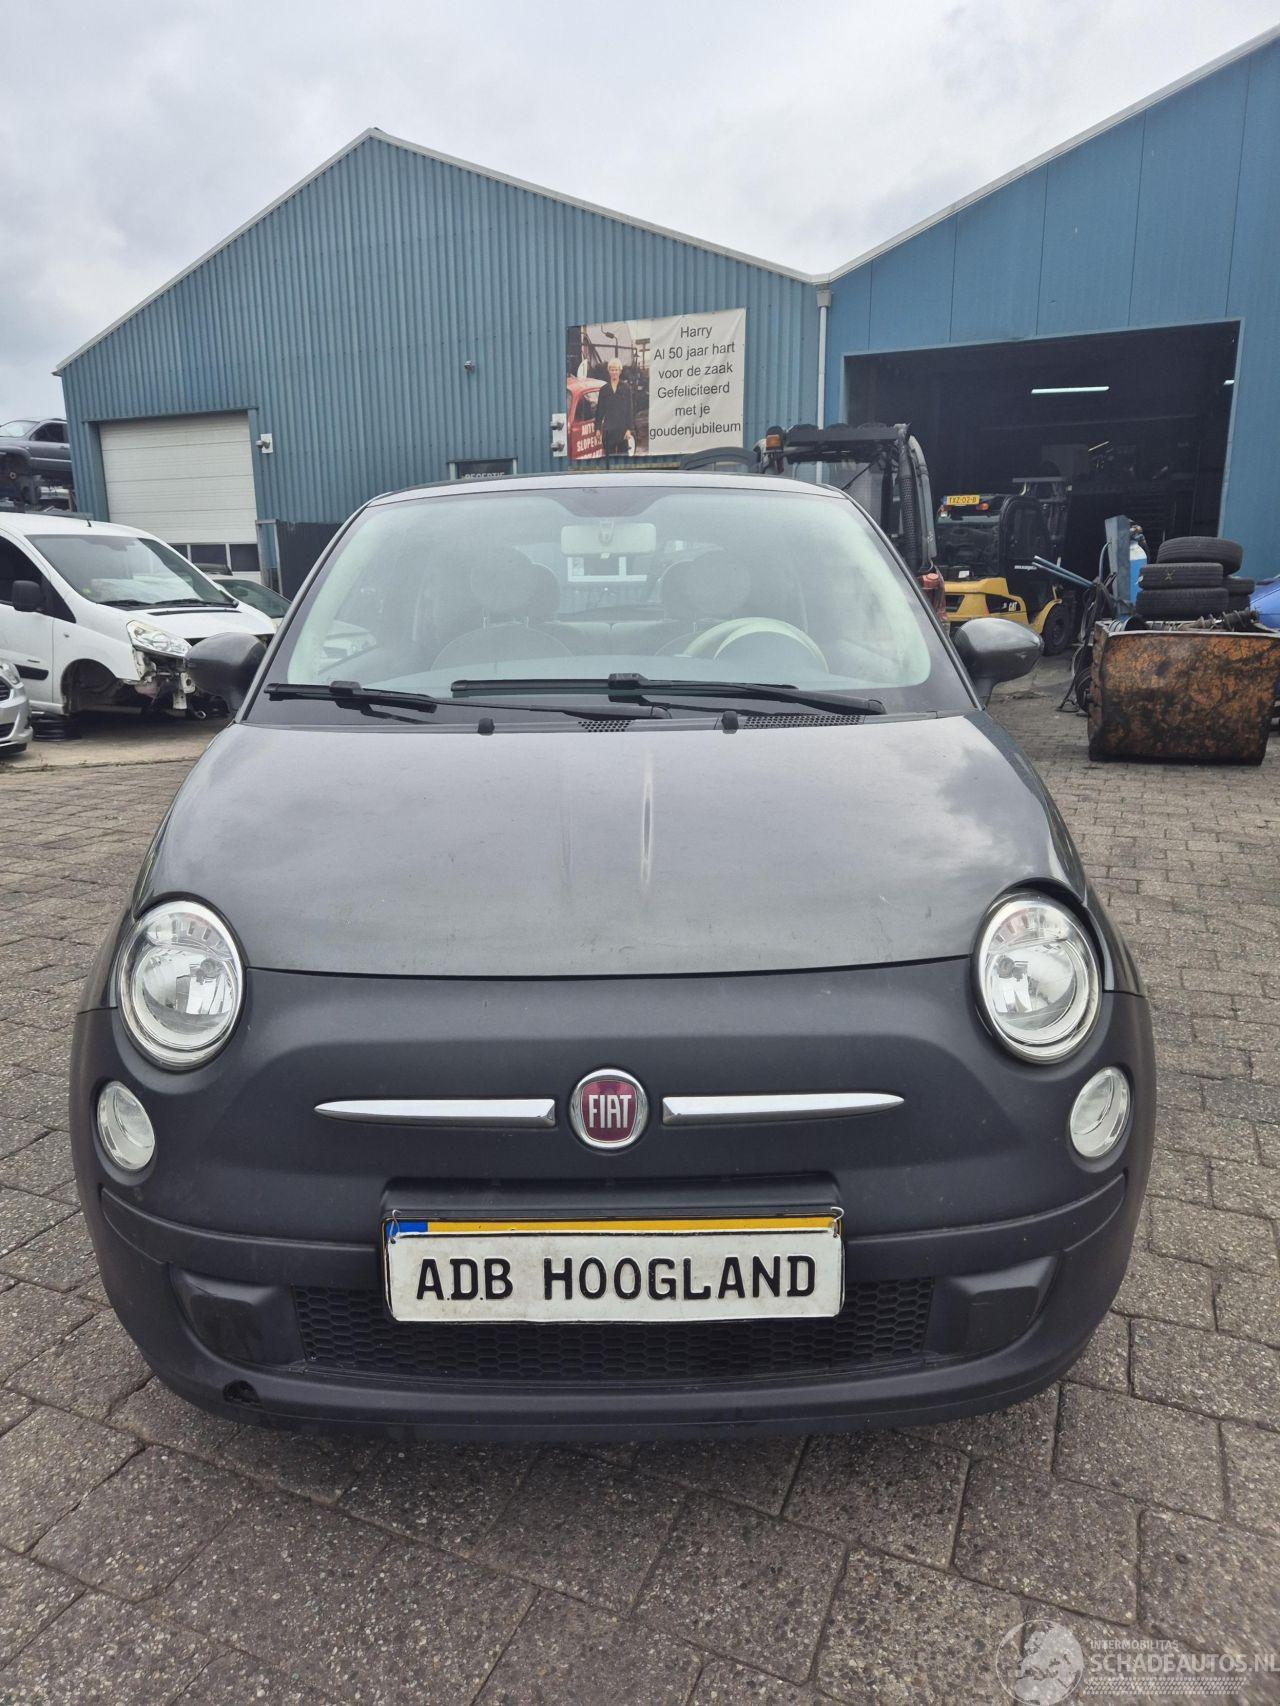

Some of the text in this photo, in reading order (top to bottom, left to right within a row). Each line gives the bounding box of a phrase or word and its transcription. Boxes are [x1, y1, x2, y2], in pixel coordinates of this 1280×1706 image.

[680, 326, 713, 339] Harry
[653, 341, 735, 361] Al 50 jaar hart
[658, 362, 733, 379] voor de zaak
[657, 382, 730, 399] Gefeliciteerd
[675, 403, 711, 418] met je
[649, 422, 741, 440] goudenjubileum
[588, 1094, 632, 1129] FIAT
[543, 1255, 816, 1301] HOOGLAND
